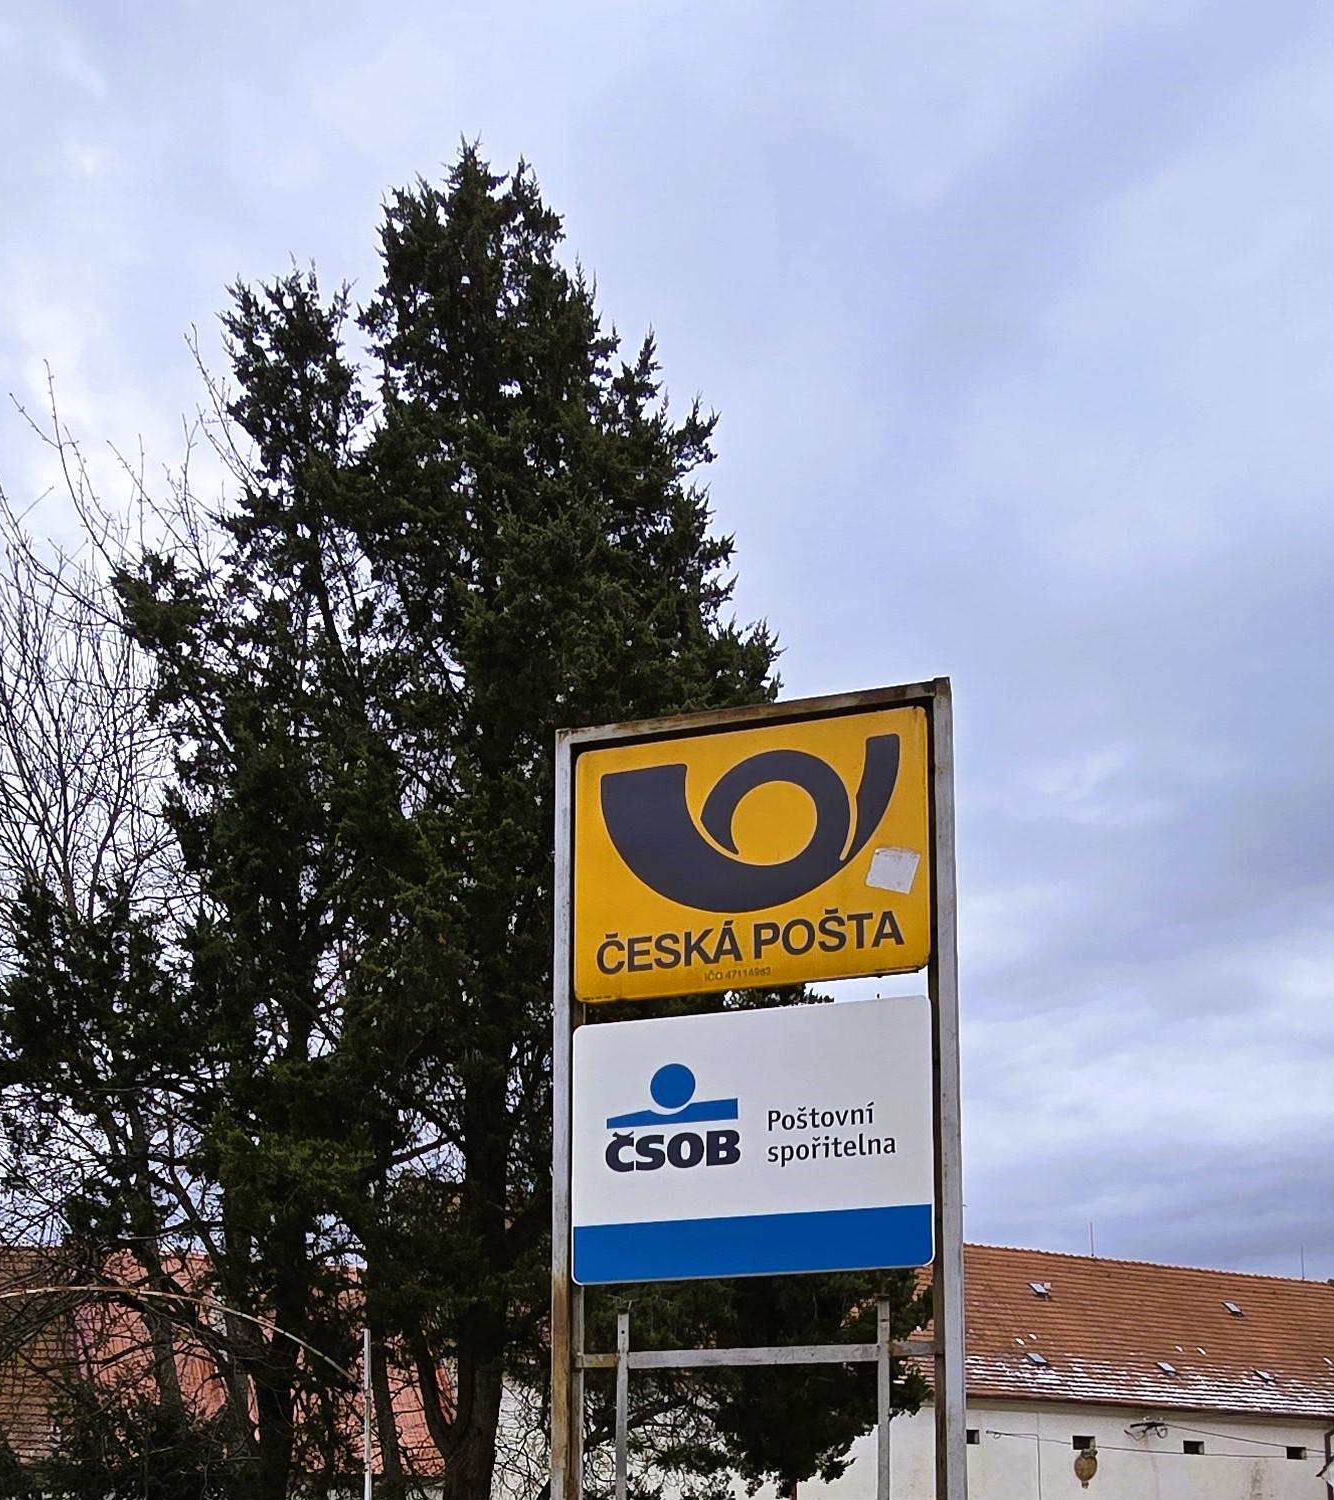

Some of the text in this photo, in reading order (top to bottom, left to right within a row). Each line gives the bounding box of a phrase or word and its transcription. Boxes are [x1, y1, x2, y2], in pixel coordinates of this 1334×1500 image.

[596, 908, 905, 975] ČESKÁ POŠTA
[767, 1102, 875, 1132] Poštovní
[605, 1129, 742, 1173] ČSOB
[767, 1133, 897, 1167] spořitelna
